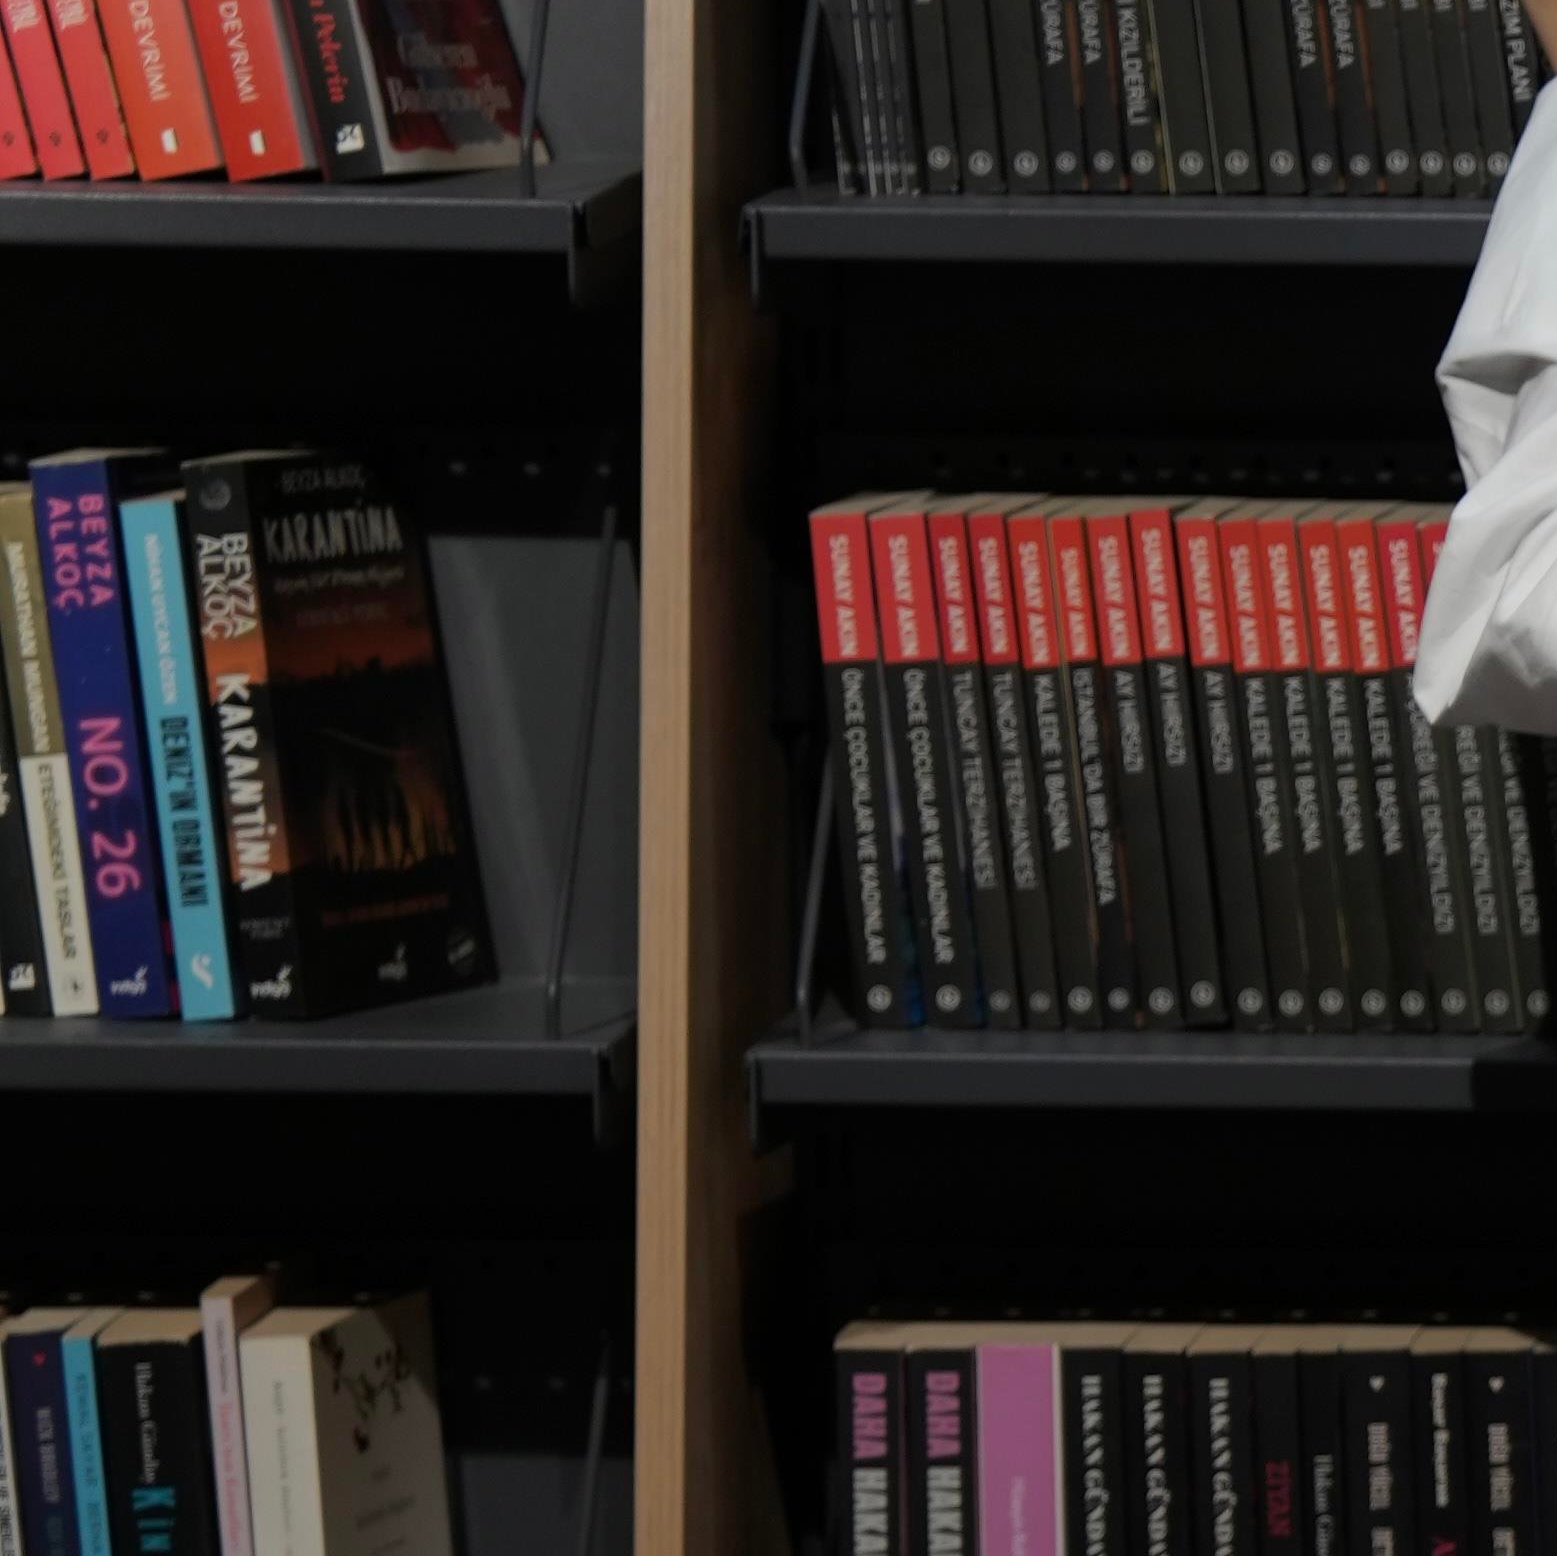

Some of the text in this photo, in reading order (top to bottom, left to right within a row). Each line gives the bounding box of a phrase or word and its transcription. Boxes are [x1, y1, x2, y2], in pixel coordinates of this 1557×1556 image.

[219, 0, 259, 104] DEVRİMİ
[312, 12, 346, 104] Pelerin
[46, 496, 86, 612] ALKOÇ
[77, 493, 116, 606] BEYZA
[888, 535, 954, 964] SUNAY AKIN ÖNCE ÇOCUKLAR VE KADINLAR
[1363, 678, 1393, 759] KALEDE
[77, 715, 140, 899] NO. 26
[212, 672, 274, 893] KARANTİNA
[1372, 778, 1404, 856] BAŞINA
[925, 1371, 960, 1459] DAHA
